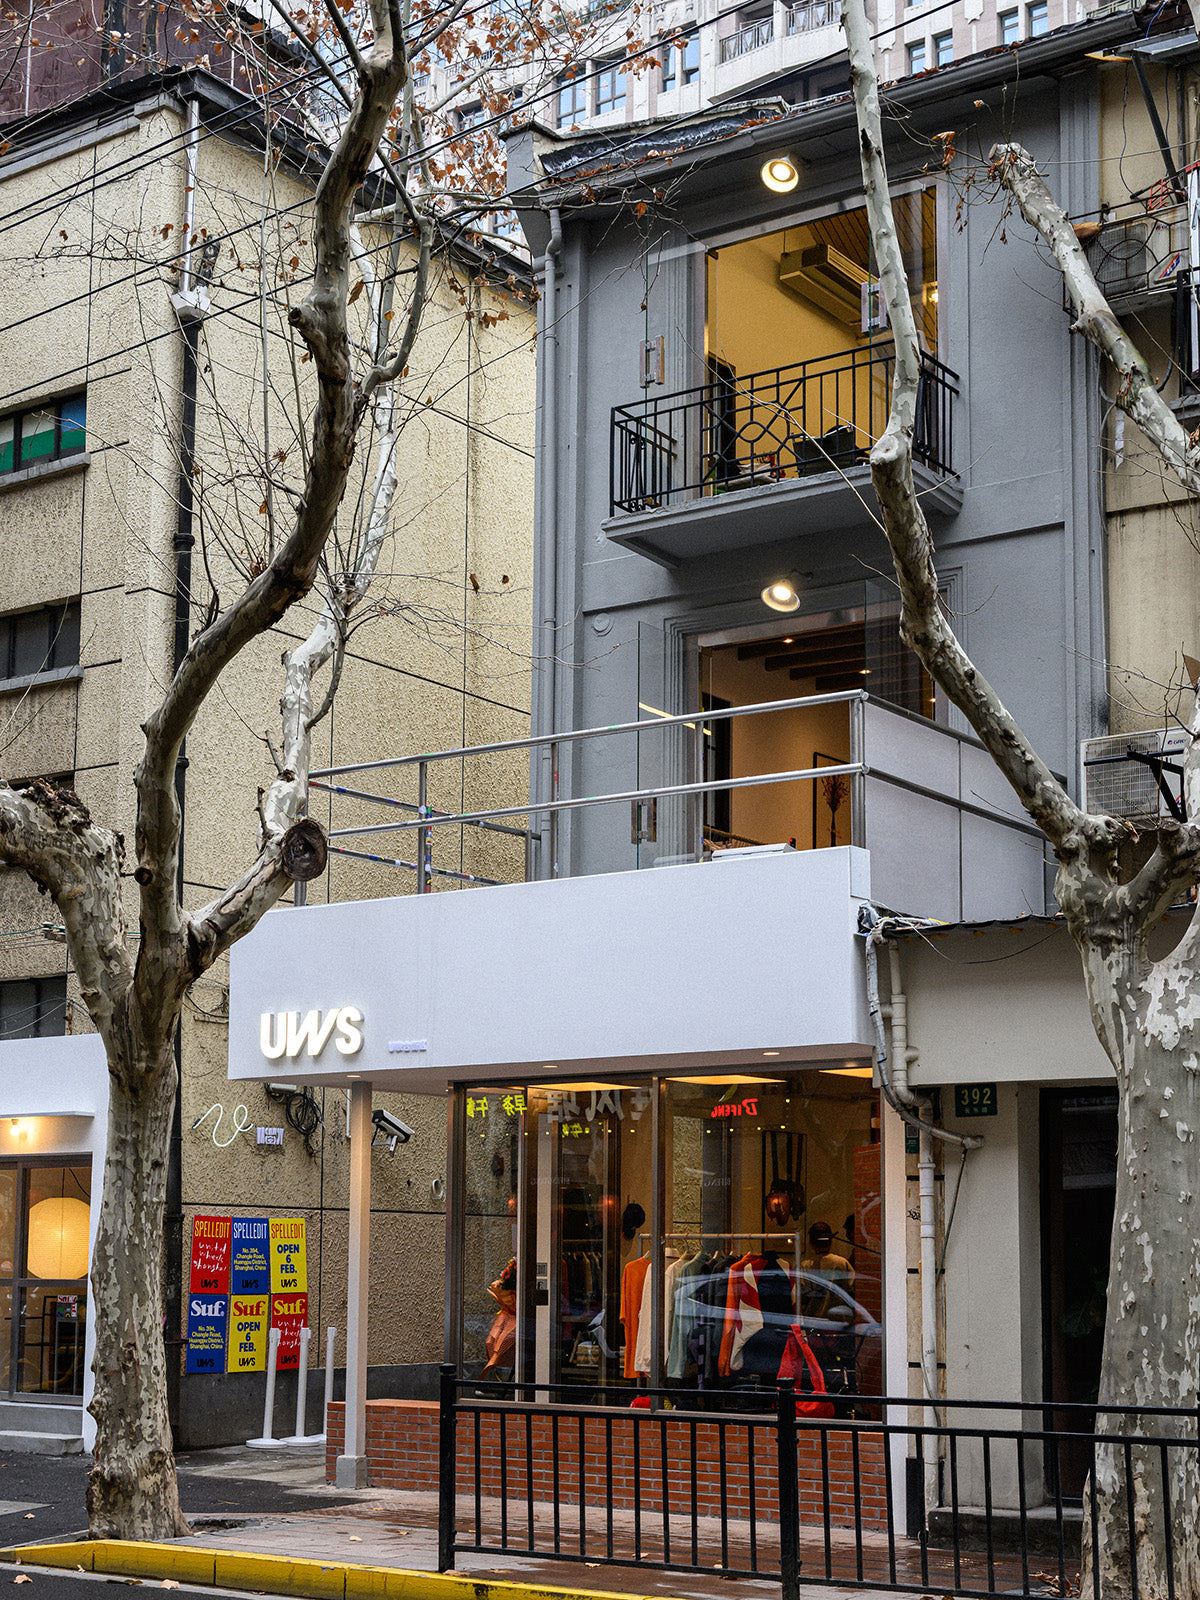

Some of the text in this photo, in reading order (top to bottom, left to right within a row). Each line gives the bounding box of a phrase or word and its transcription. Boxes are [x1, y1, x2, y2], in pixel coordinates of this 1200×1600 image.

[260, 1006, 363, 1058] UWS
[961, 1087, 991, 1105] 392
[194, 1220, 230, 1238] SPELLEDIT
[233, 1222, 267, 1239] SPELLEDIT
[271, 1223, 304, 1239] SPELLEDIT
[277, 1244, 300, 1254] OPEN
[286, 1254, 292, 1263] 6
[280, 1264, 297, 1274] FEB.
[200, 1279, 218, 1288] UWS
[242, 1280, 259, 1288] UWS
[281, 1279, 298, 1288] UWS
[237, 1322, 260, 1332] OPEN
[246, 1332, 251, 1341] 6
[239, 1342, 256, 1352] FEB.
[196, 1358, 214, 1368] UWS
[239, 1358, 256, 1366] UWS
[281, 1354, 298, 1364] UWS
